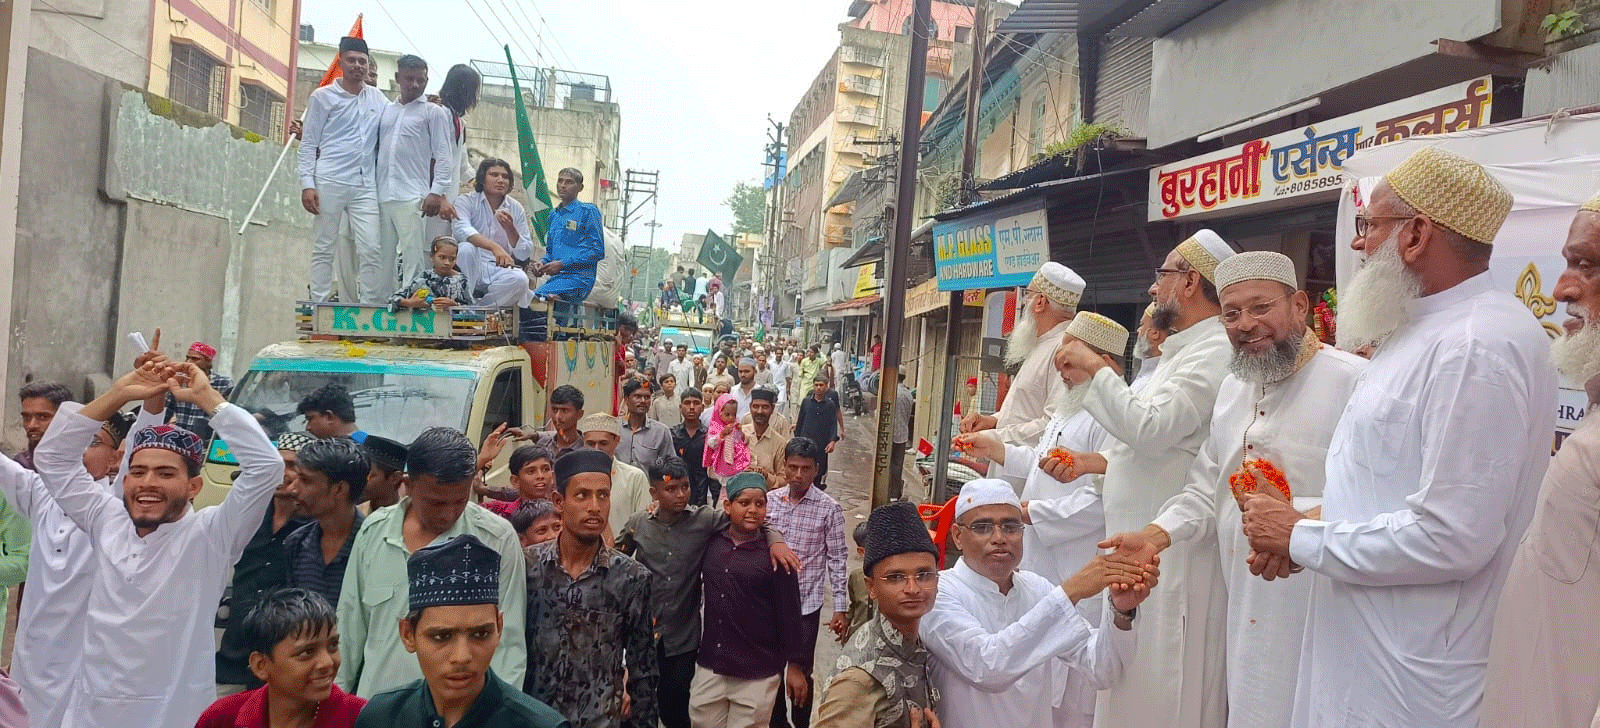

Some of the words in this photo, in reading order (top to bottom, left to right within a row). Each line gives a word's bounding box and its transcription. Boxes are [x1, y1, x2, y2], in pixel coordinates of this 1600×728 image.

[1158, 139, 1271, 219] बुरहानी
[956, 224, 992, 257] GLASS
[940, 264, 953, 281] AND
[953, 259, 994, 279] HARDWARE
[333, 306, 436, 334] K.G.N
